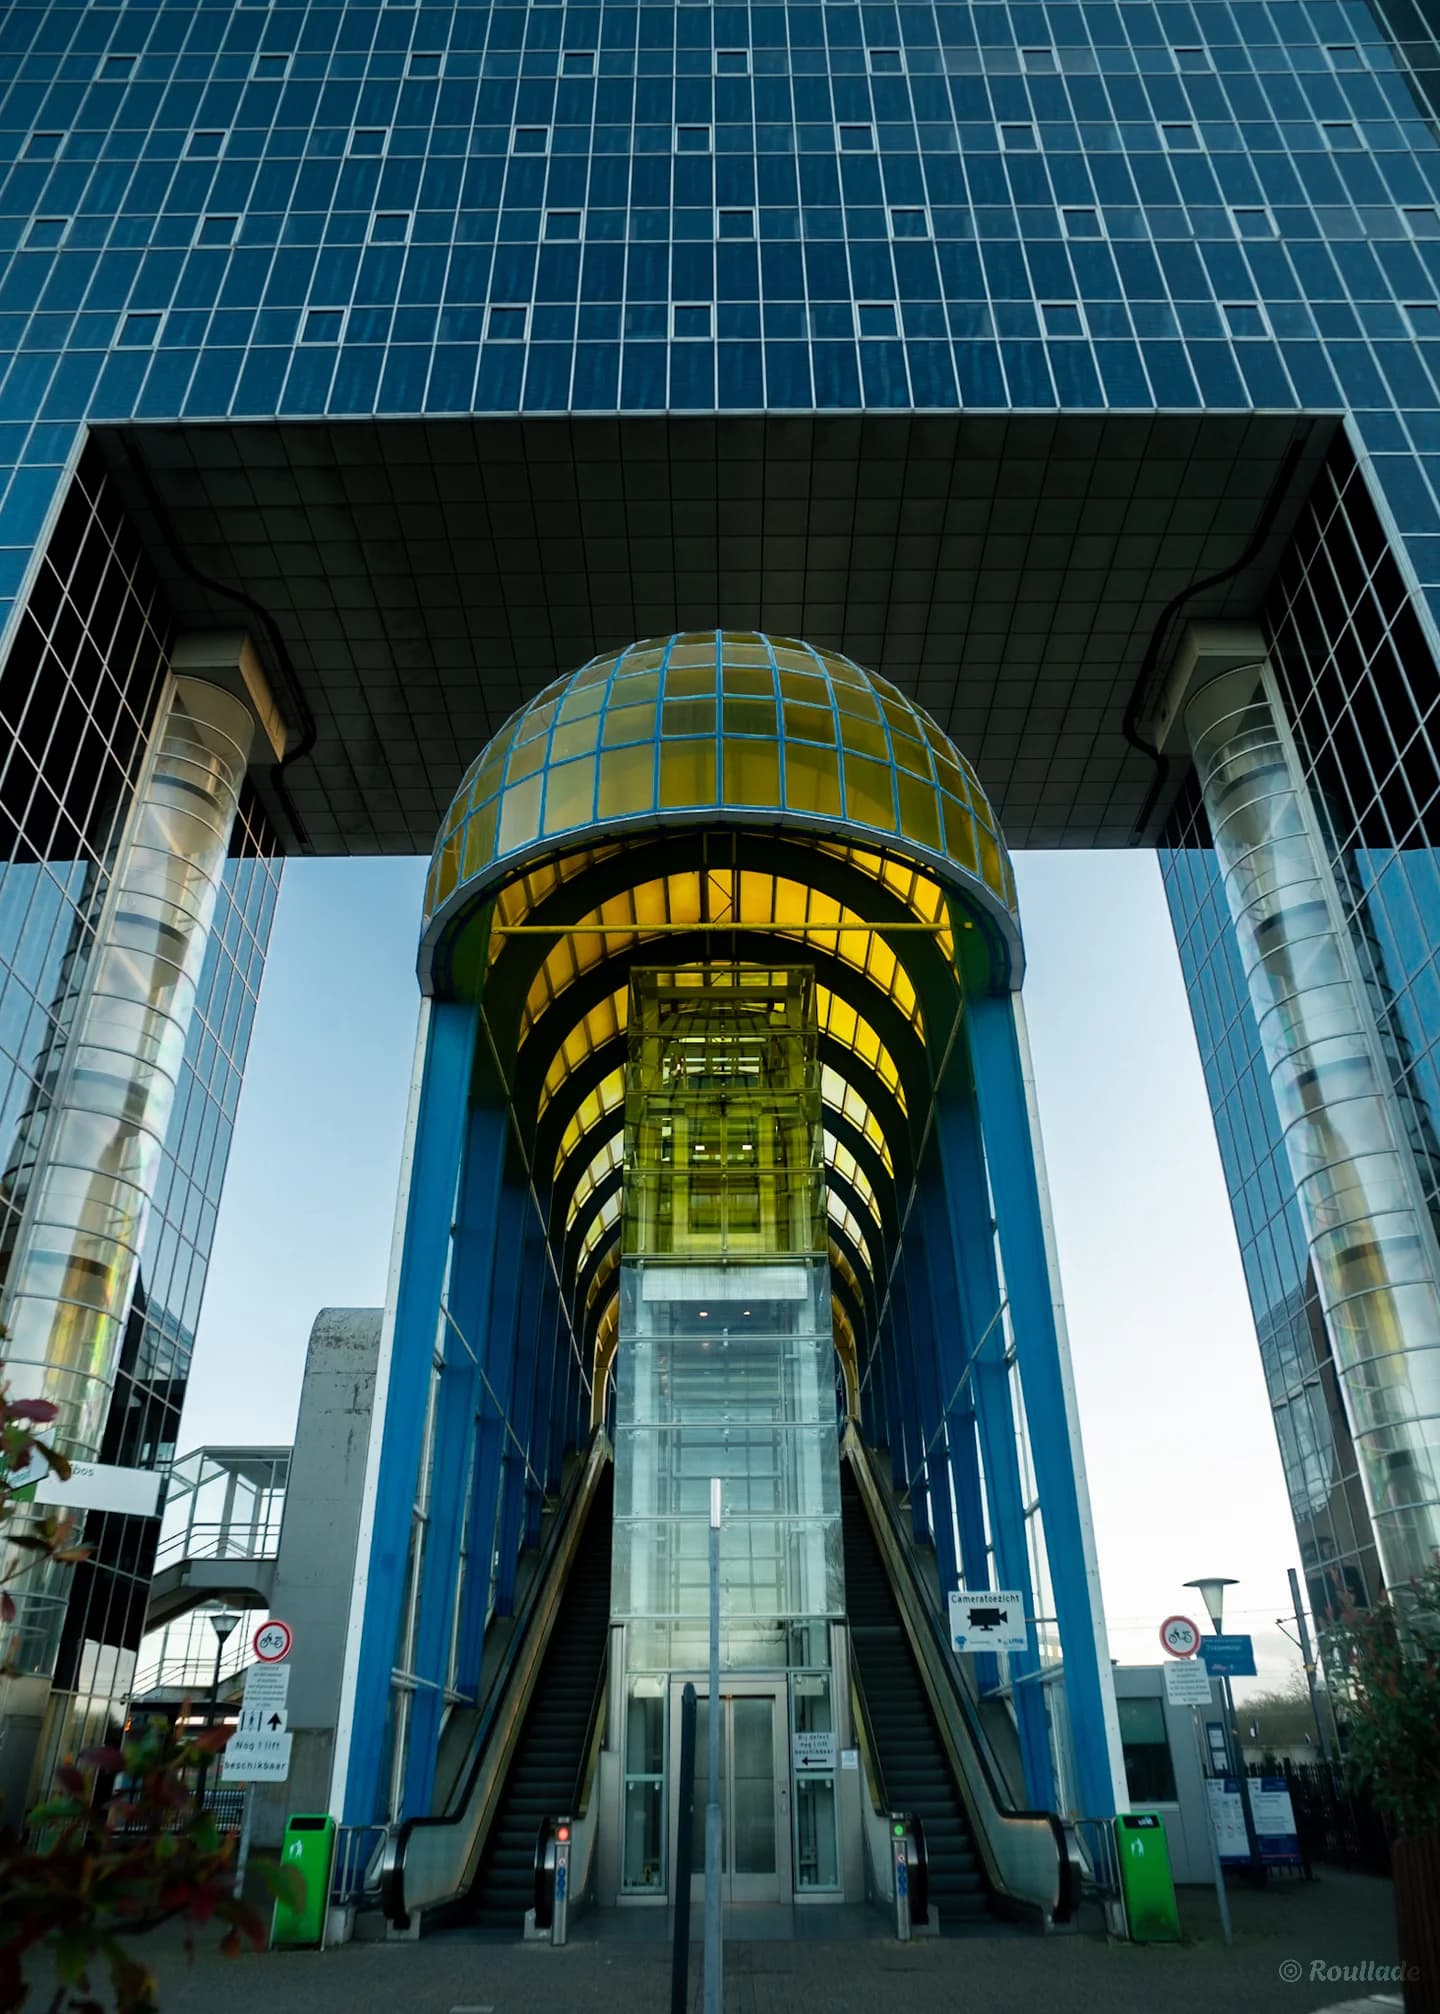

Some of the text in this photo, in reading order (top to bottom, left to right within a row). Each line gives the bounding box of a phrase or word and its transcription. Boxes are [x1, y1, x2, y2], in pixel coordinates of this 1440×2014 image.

[951, 1593, 1020, 1604] Cameratoezicht
[235, 1741, 255, 1752] Nog
[264, 1741, 280, 1751] lift
[224, 1760, 287, 1771] beschikbaar
